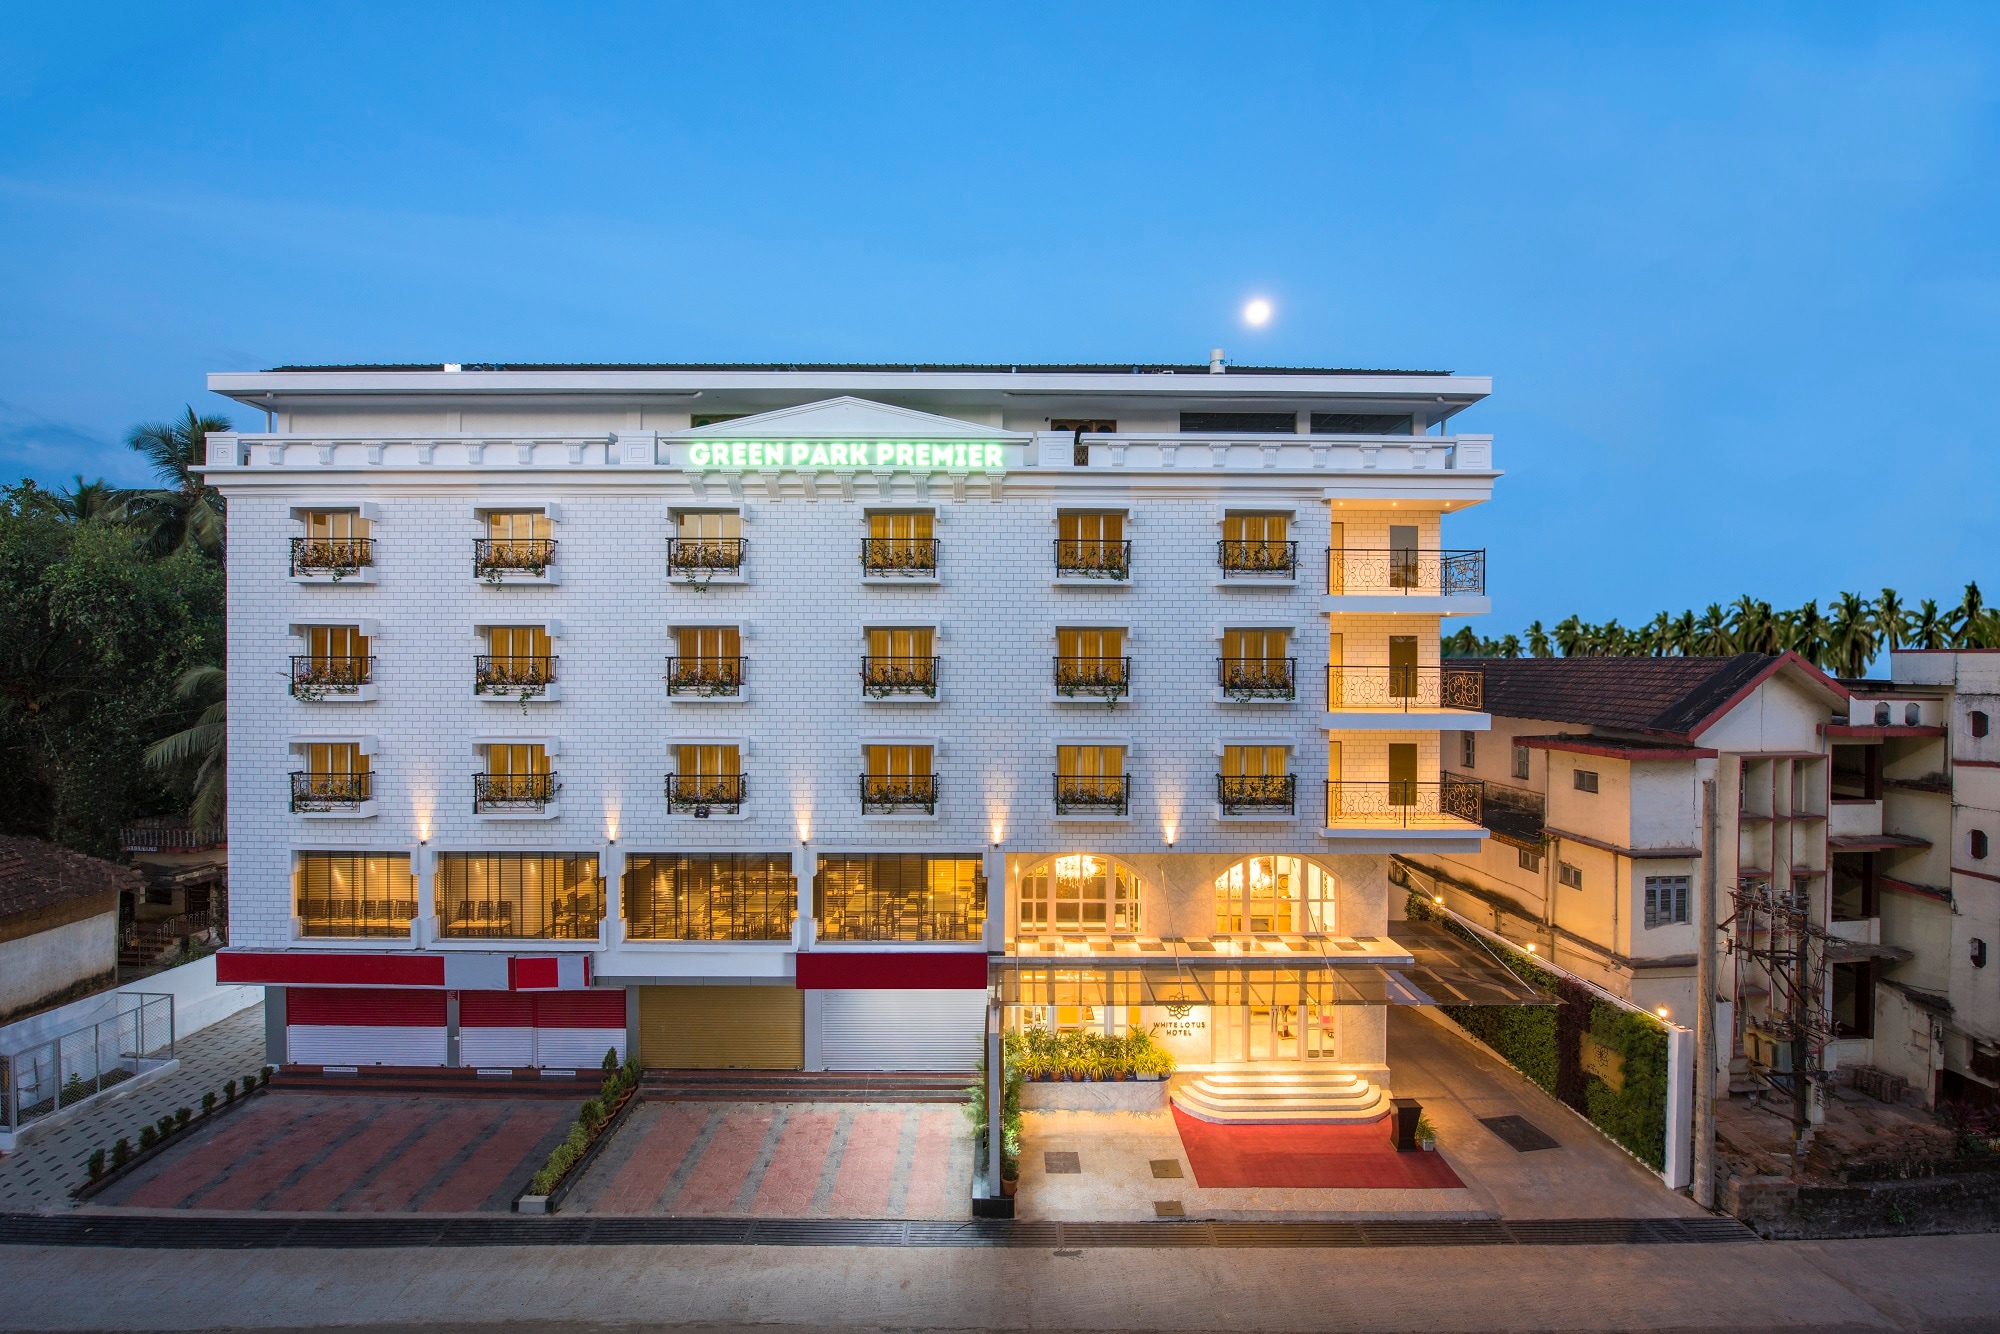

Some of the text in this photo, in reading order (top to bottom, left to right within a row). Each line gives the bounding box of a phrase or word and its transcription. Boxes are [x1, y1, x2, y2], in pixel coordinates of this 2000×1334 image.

[690, 443, 1003, 467] GREEN PARK PREMIER
[1166, 1029, 1192, 1037] HOTEL
